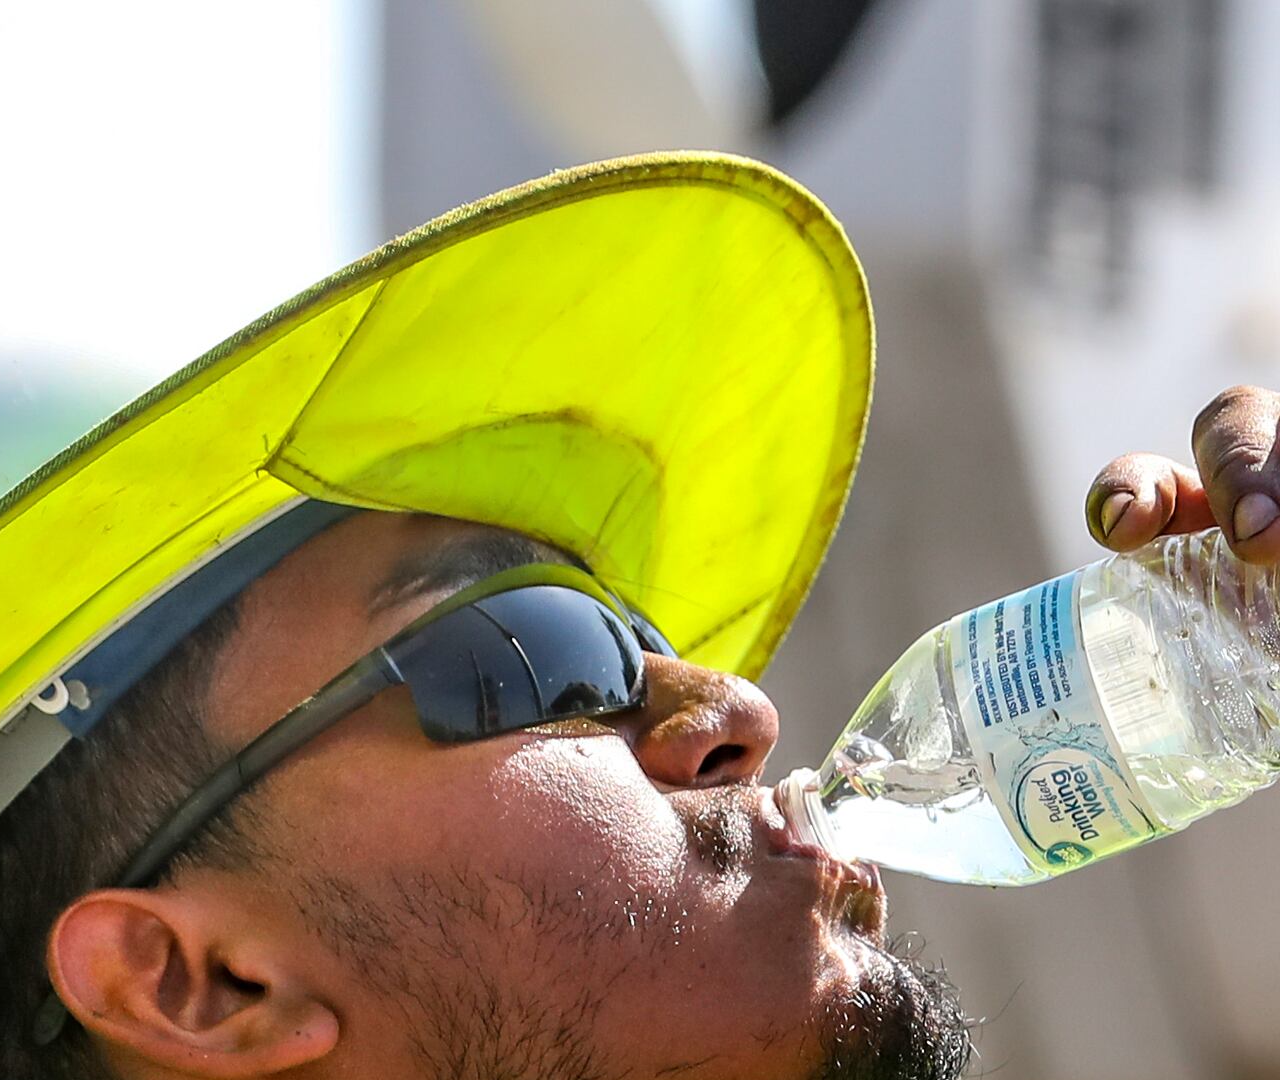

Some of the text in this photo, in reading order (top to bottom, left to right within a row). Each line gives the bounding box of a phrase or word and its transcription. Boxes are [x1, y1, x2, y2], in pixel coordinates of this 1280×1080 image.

[995, 648, 1006, 662] BY:
[1005, 628, 1030, 714] Bentonville, AR 72716
[1025, 654, 1037, 669] BY:
[996, 662, 1018, 718] DISTRIBUTED
[1027, 669, 1047, 708] PURIFIED
[1030, 776, 1064, 823] Purified
[1049, 768, 1099, 841] Drinking
[1067, 763, 1106, 820] Water
